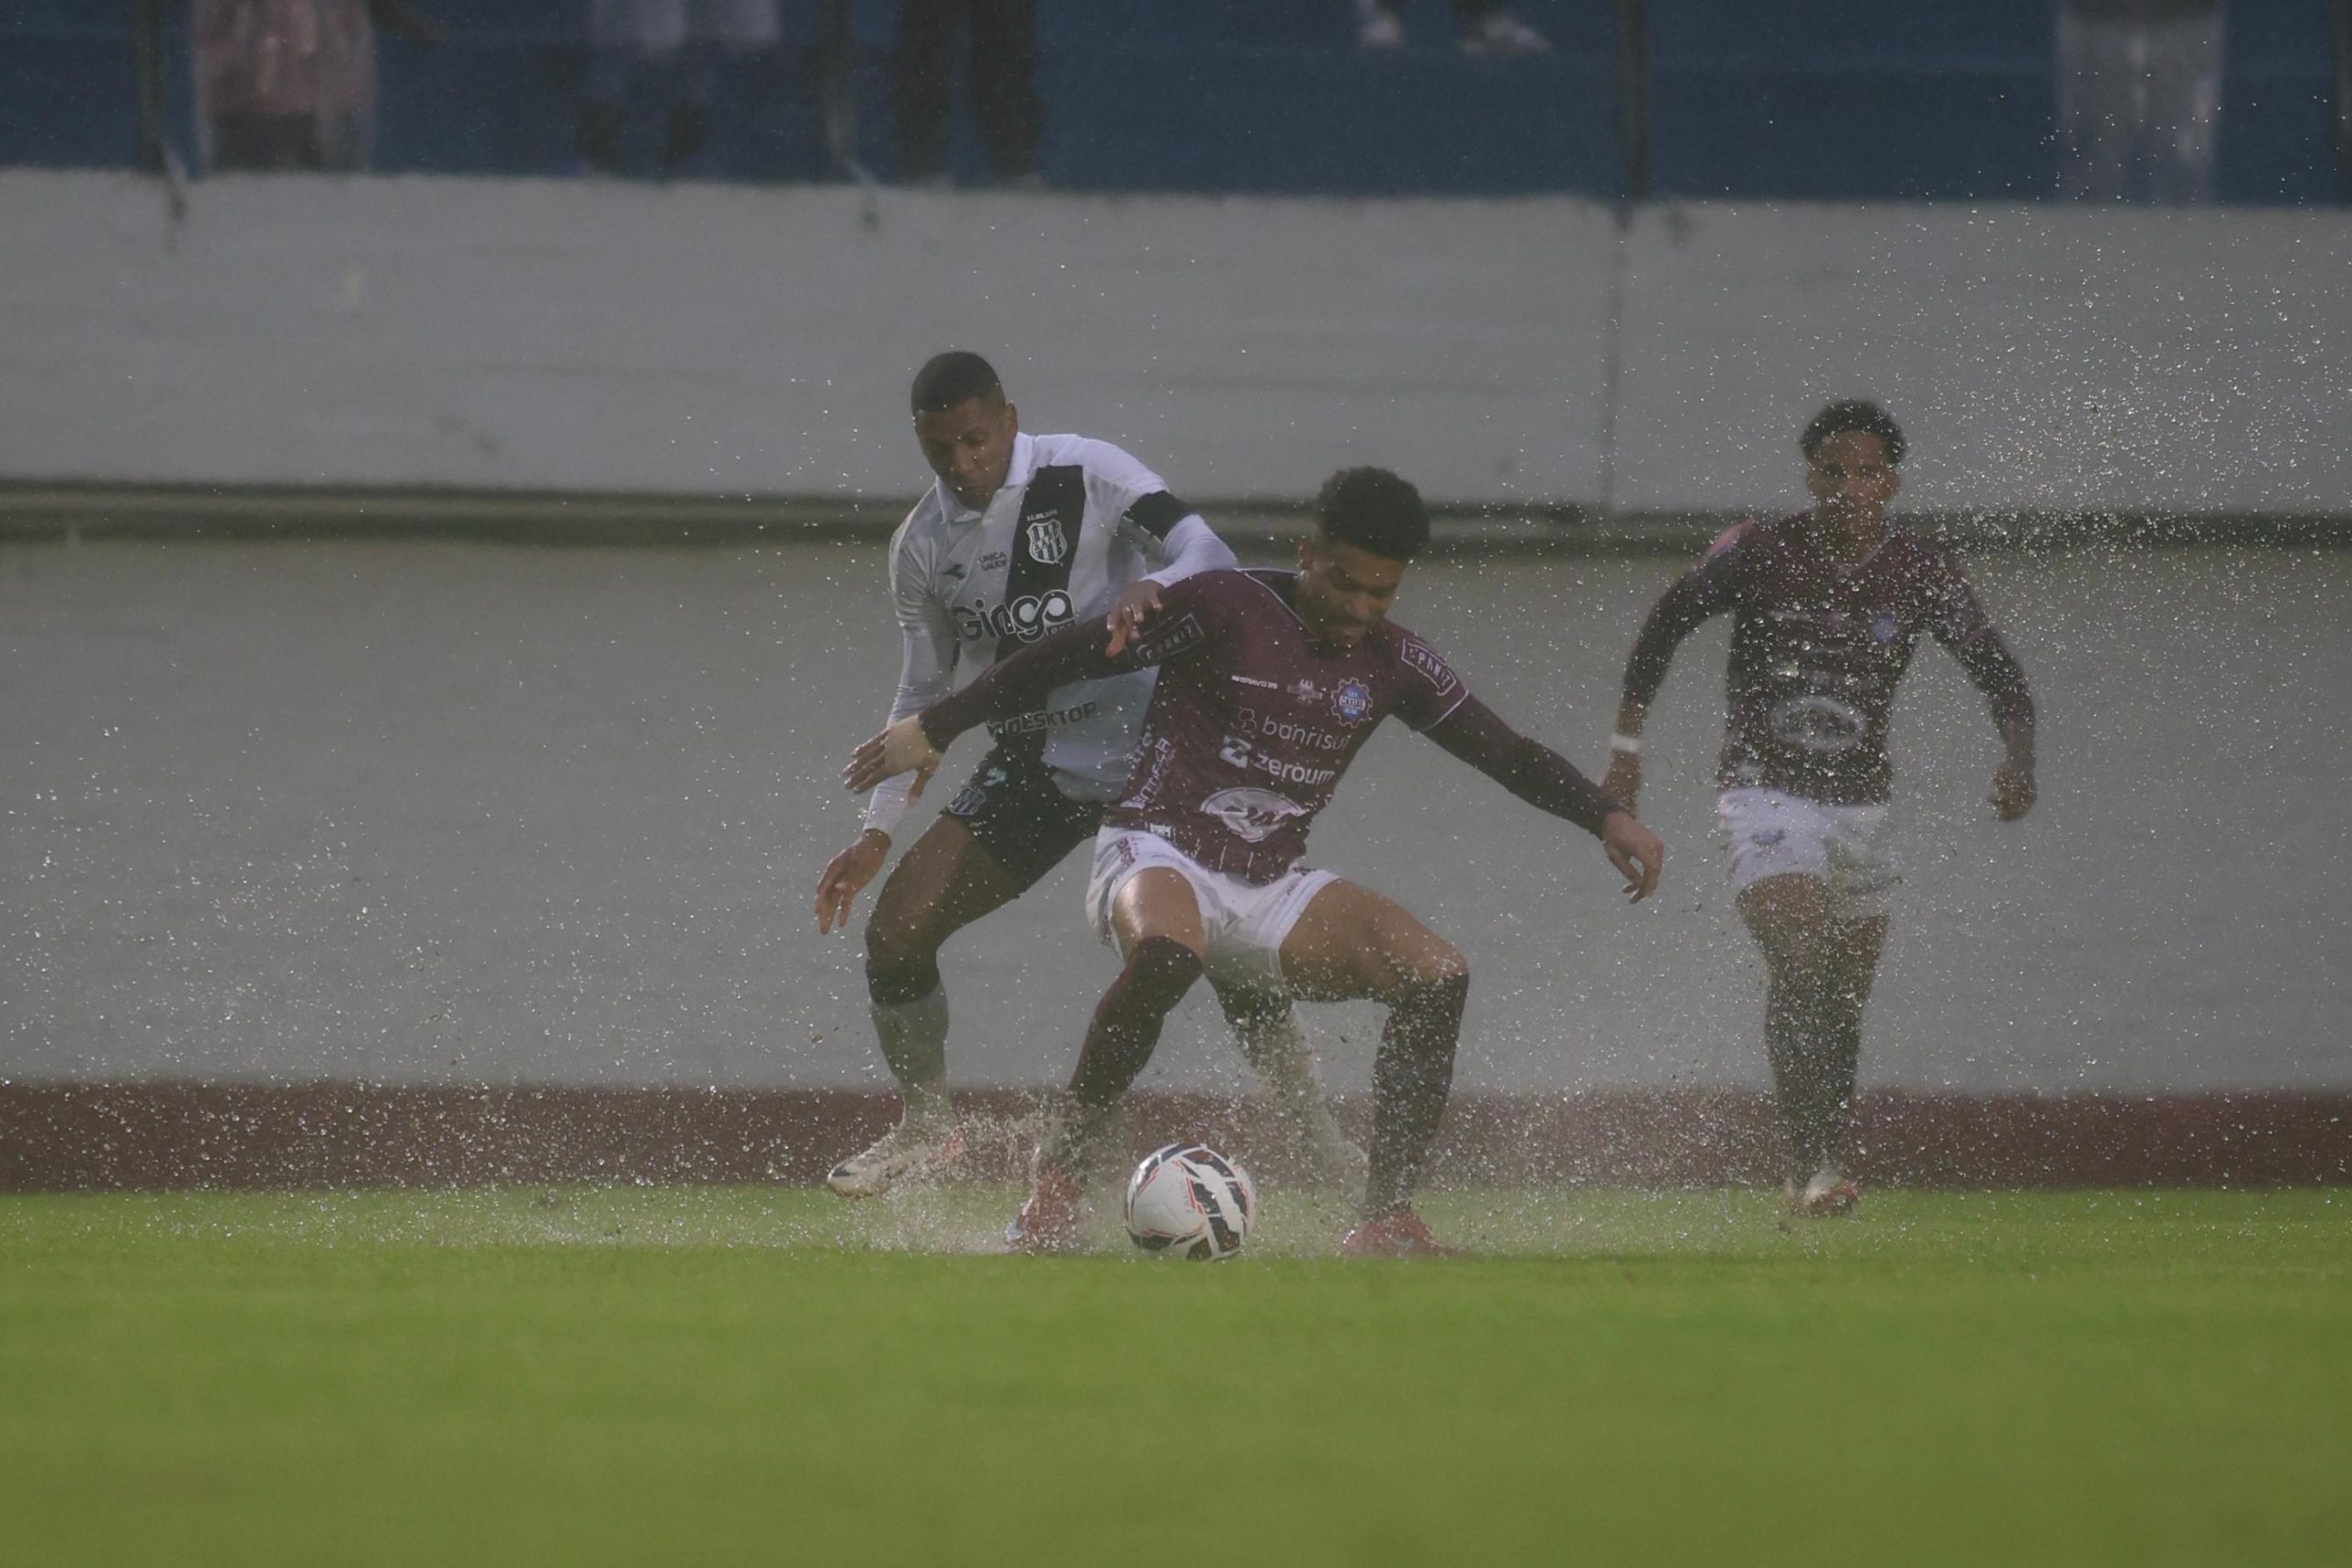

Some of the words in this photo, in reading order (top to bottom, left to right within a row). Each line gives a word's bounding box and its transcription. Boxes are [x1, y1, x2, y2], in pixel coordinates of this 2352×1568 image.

[952, 589, 1074, 644] Ginga
[1005, 701, 1097, 736] DESKTOP
[1262, 715, 1351, 750] banrisul
[1253, 753, 1335, 785] zeroum
